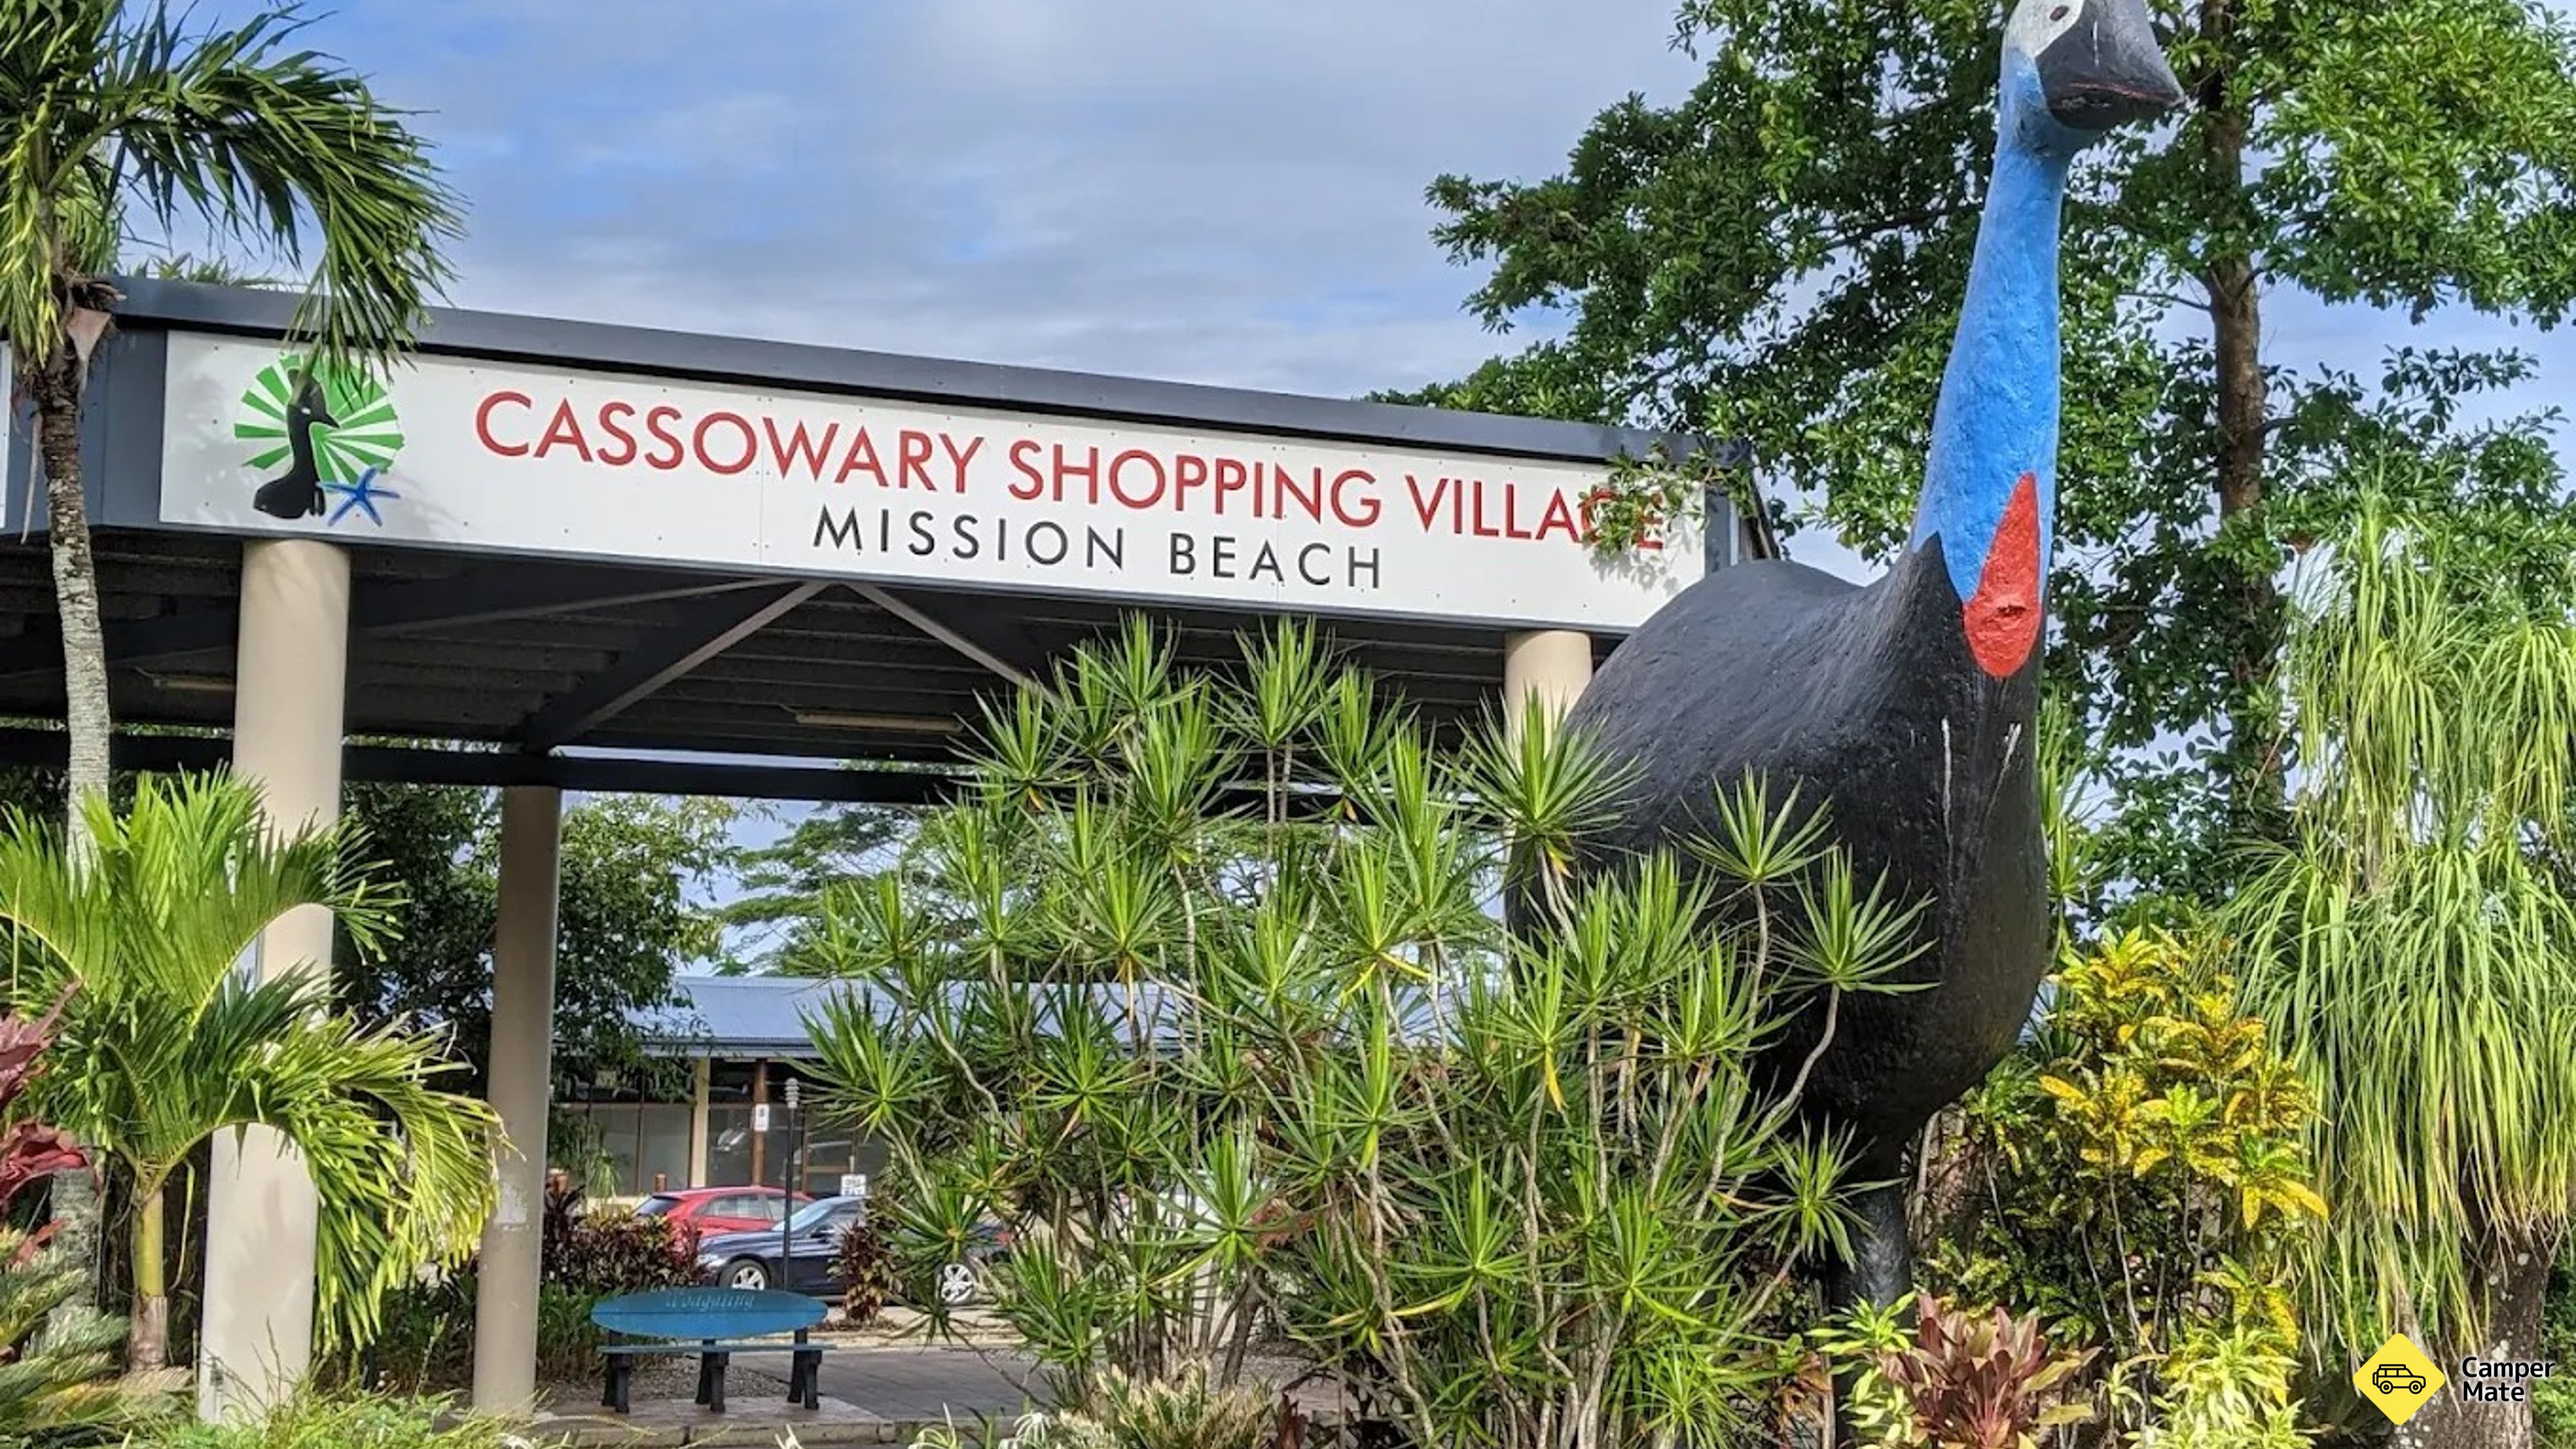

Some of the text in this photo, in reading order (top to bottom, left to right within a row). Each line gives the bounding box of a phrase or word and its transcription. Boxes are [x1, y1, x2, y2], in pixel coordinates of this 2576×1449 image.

[475, 391, 985, 493] CASSOWARY
[1008, 439, 1381, 528] SHOPPING
[813, 504, 1381, 589] MISSION BEACH
